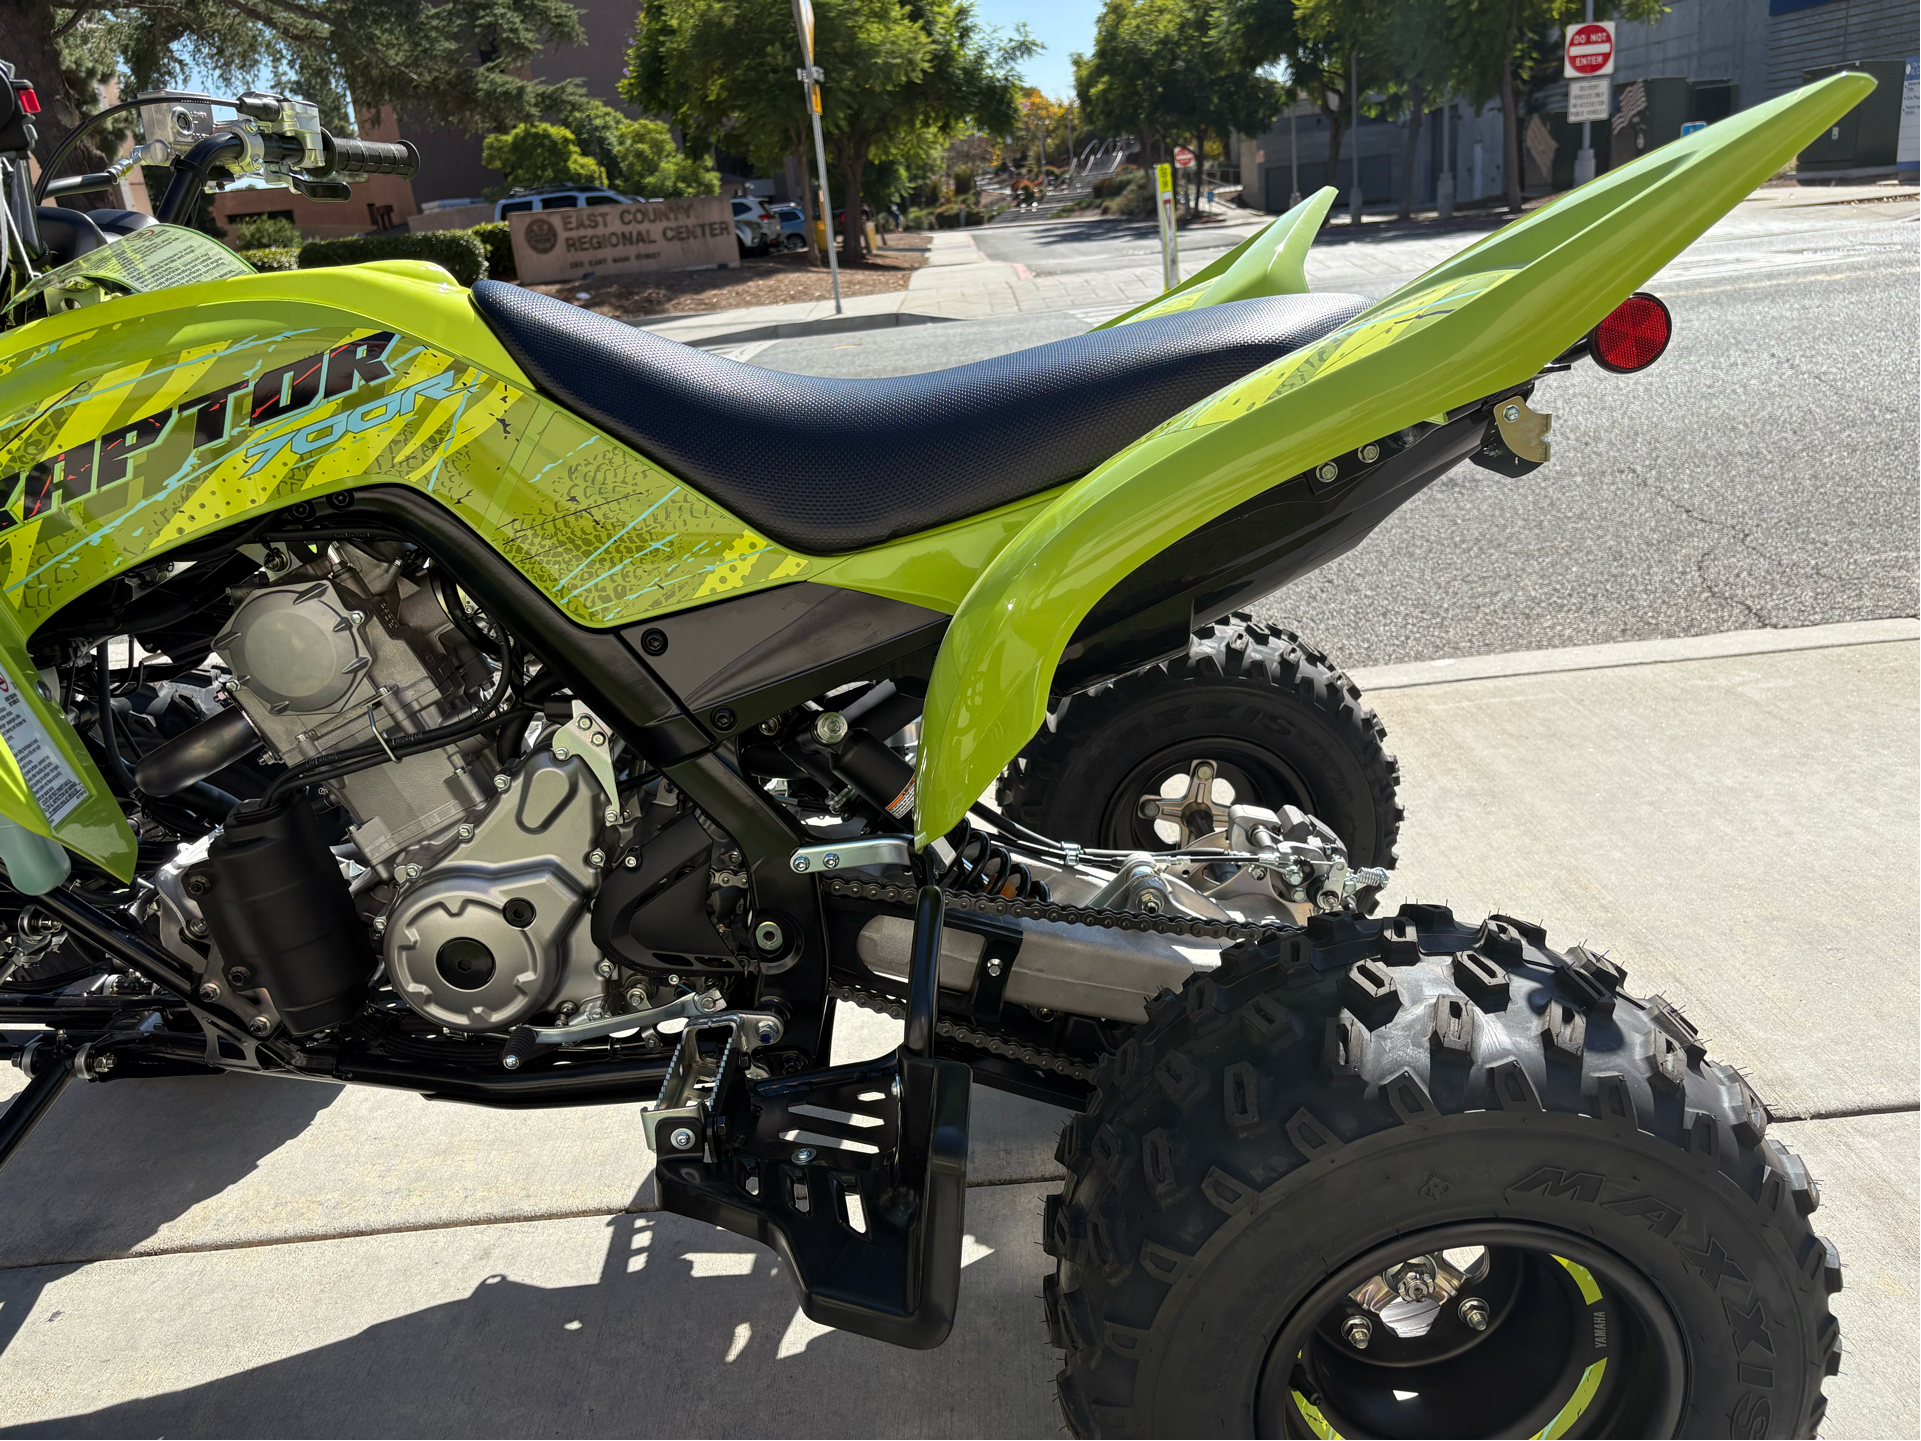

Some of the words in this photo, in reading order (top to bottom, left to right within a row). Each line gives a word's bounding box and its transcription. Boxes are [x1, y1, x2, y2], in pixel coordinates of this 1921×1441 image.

[1574, 35, 1587, 45] DO
[1590, 32, 1608, 43] NOT
[1575, 55, 1603, 67] ENTER
[561, 212, 609, 232] EAST
[619, 204, 693, 226] COUNTY
[565, 230, 657, 253] REGIONAL
[662, 221, 731, 242] CENTER
[239, 370, 477, 478] 700R
[1507, 1167, 1777, 1440] MAXXIS
[1593, 1311, 1607, 1348] YAMAHA
